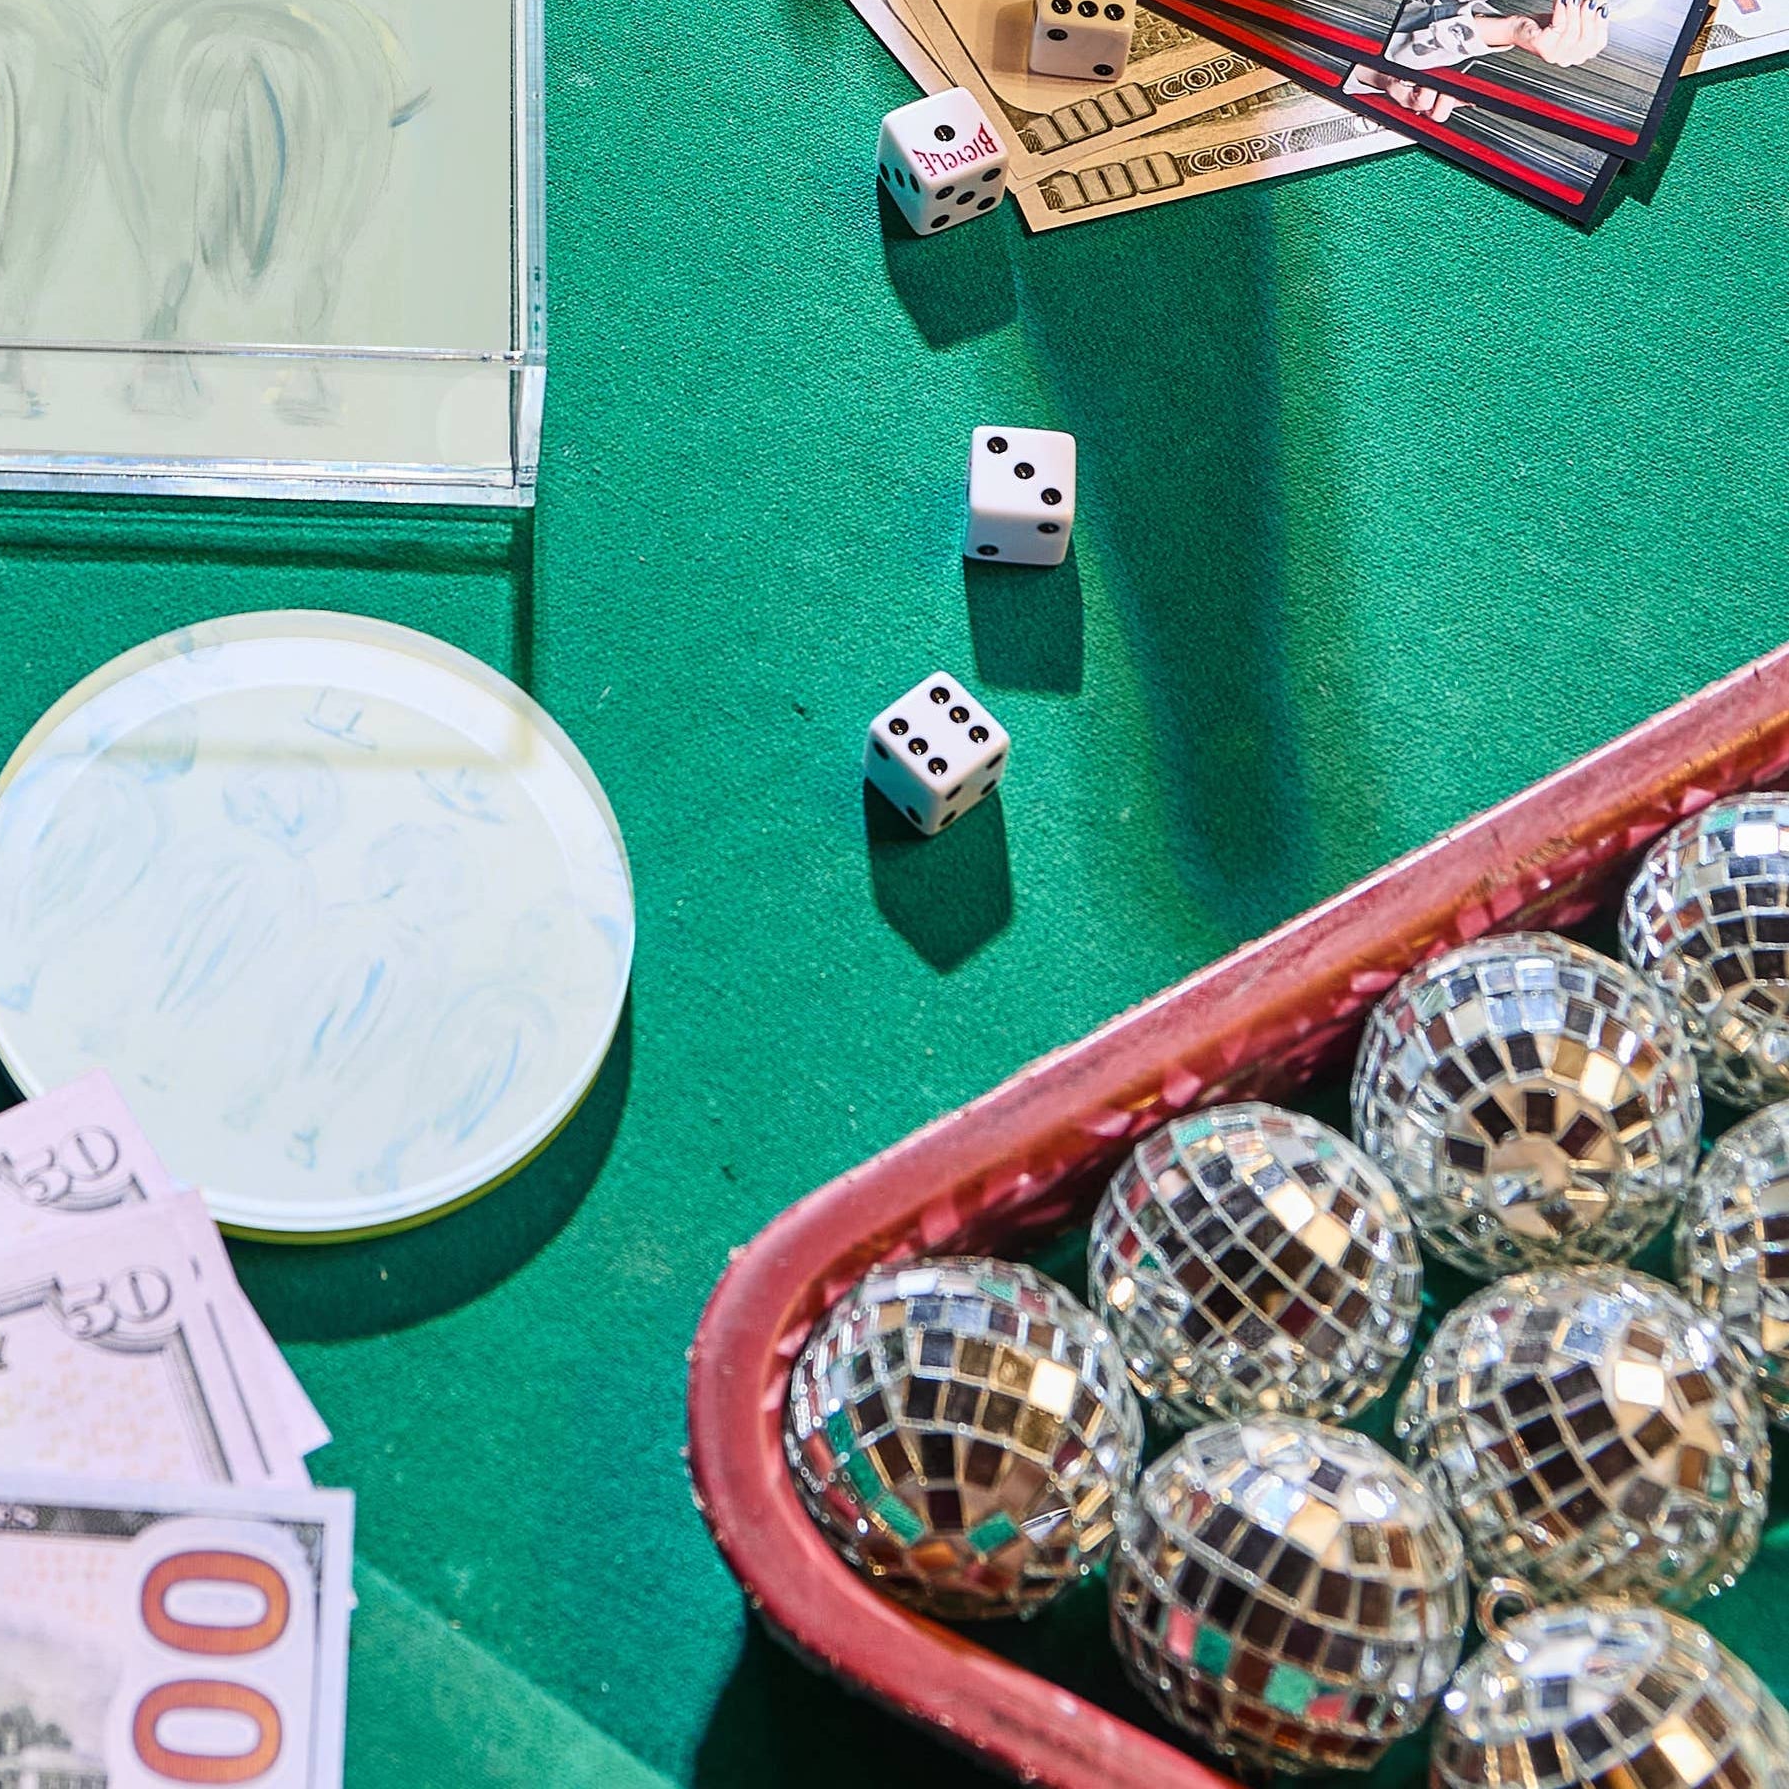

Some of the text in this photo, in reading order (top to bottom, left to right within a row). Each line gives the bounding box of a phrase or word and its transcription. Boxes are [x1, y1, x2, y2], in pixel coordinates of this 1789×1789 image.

[1030, 51, 1258, 155] 100 COPY
[913, 123, 998, 178] BICYCLE
[1054, 129, 1293, 212] 100 COPY
[22, 1126, 119, 1206] 50
[63, 1265, 172, 1339] 50
[132, 1549, 291, 1785] 00
